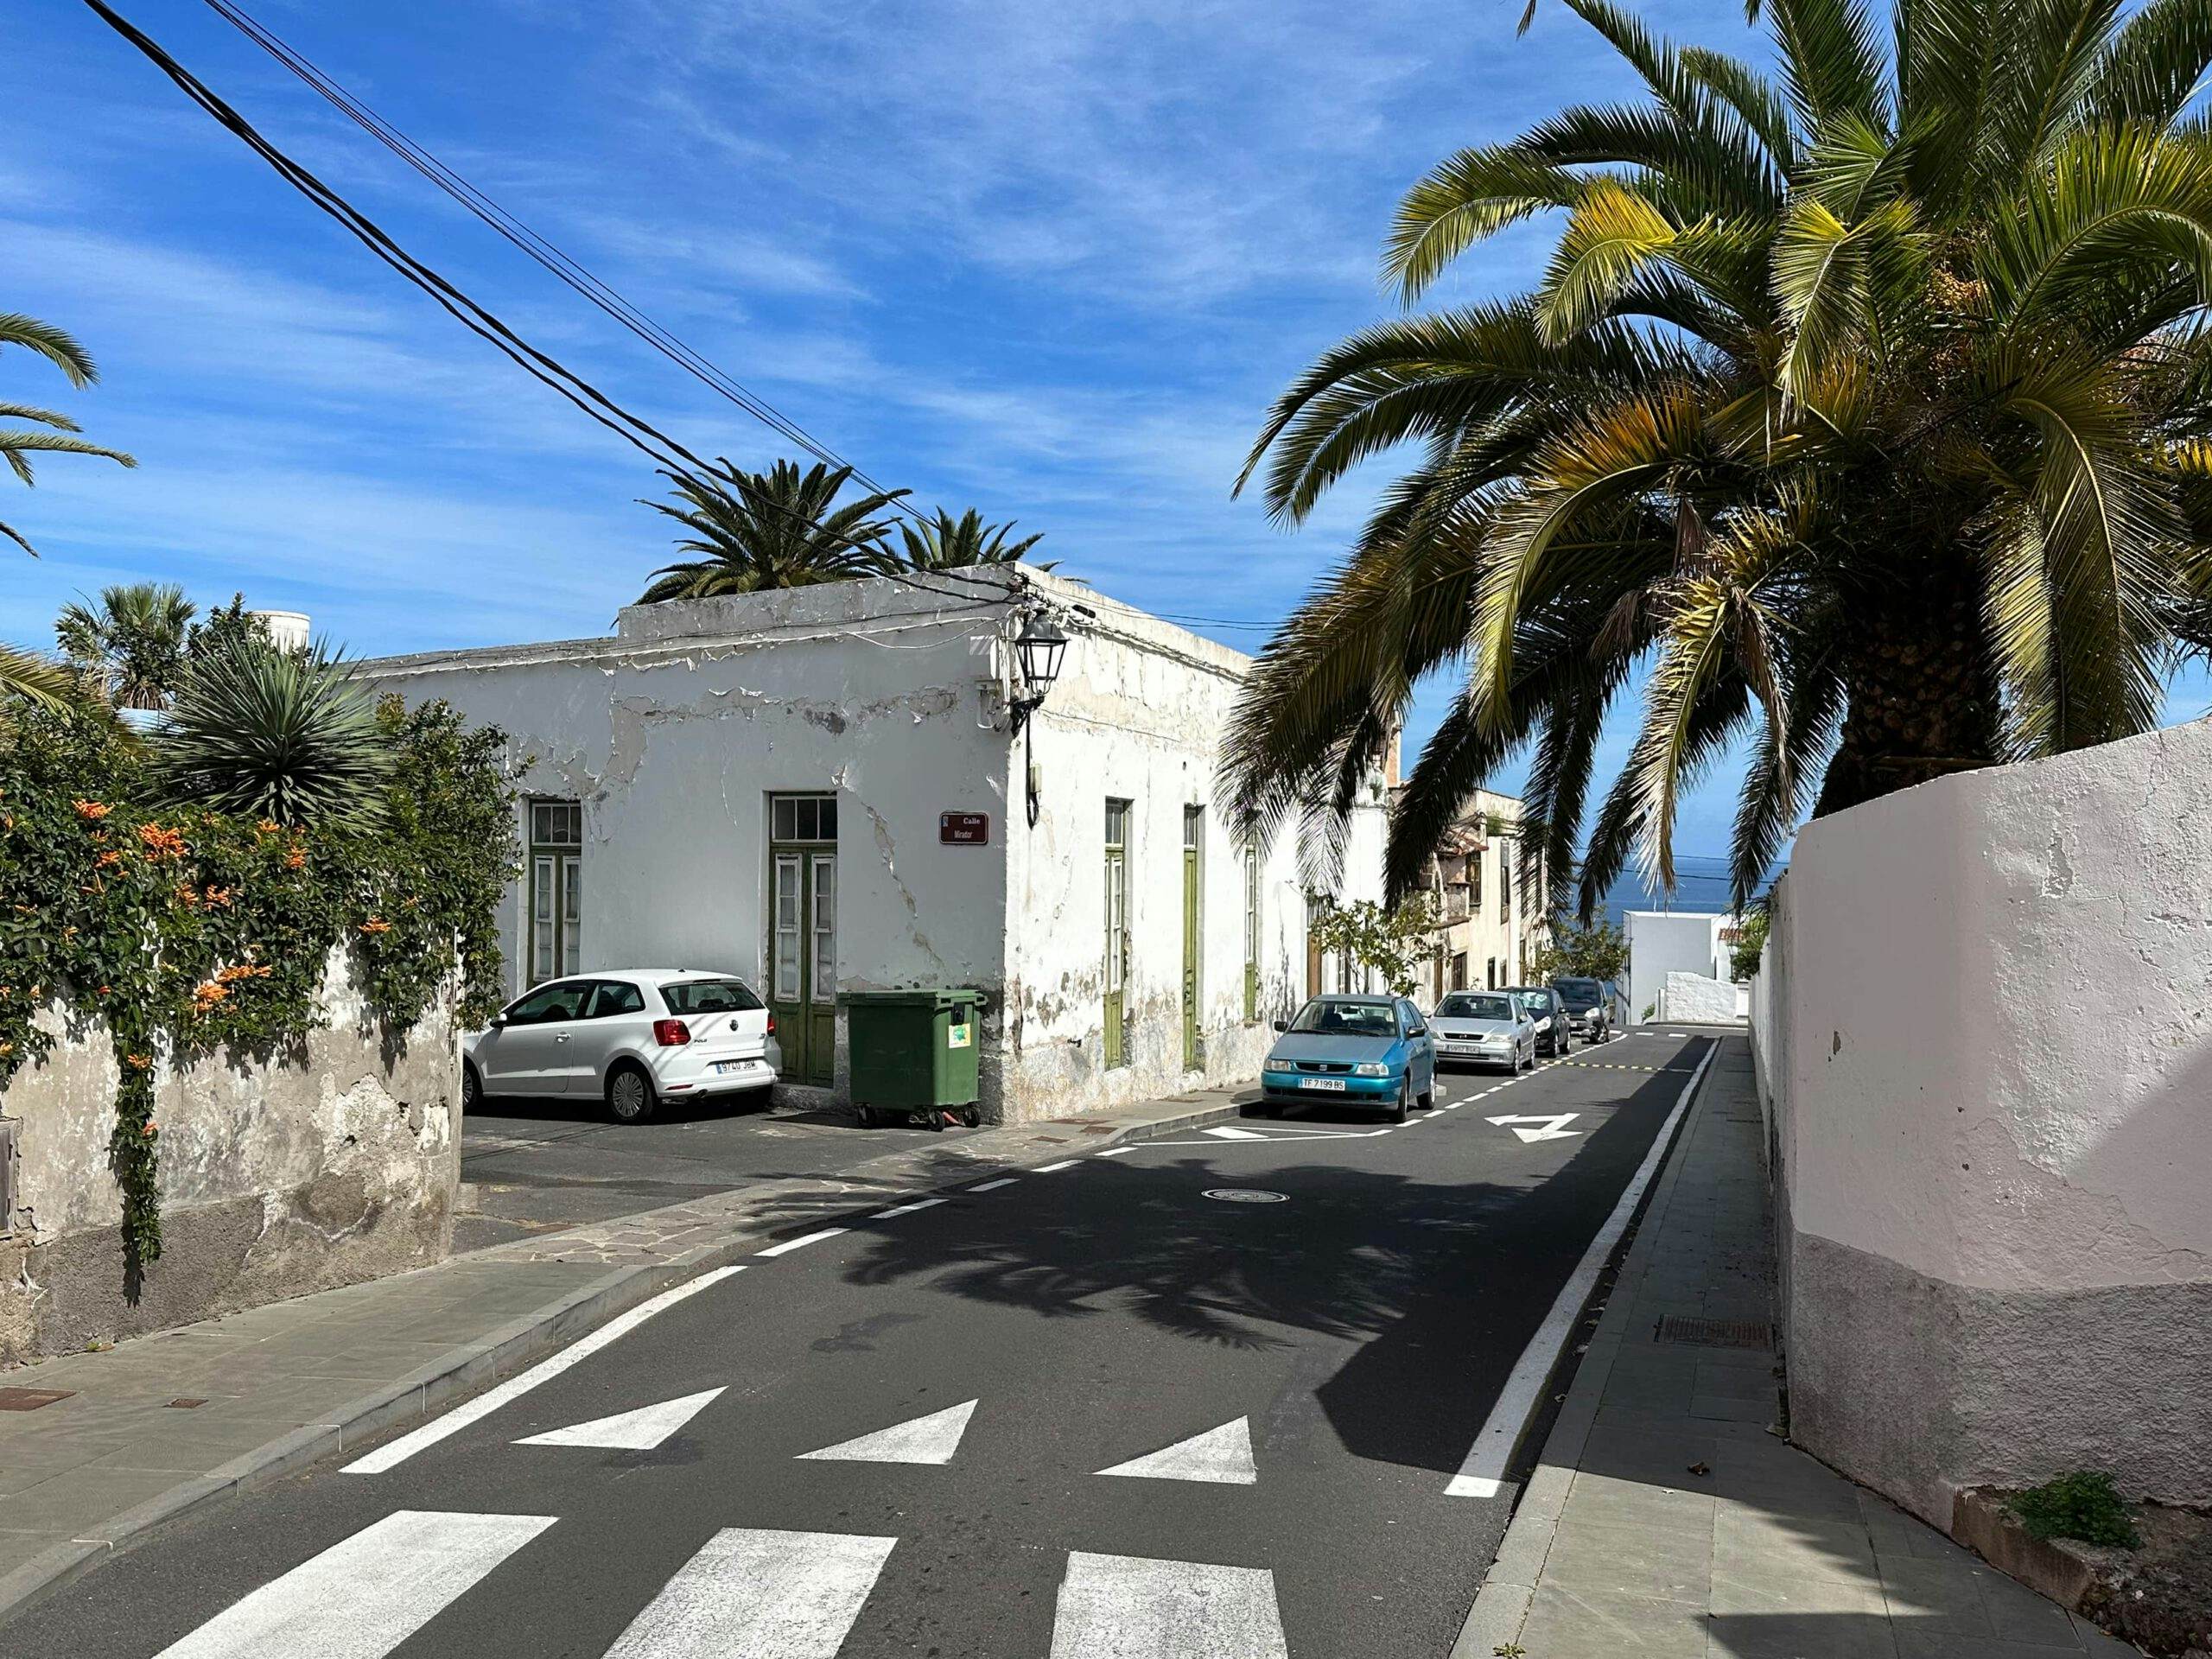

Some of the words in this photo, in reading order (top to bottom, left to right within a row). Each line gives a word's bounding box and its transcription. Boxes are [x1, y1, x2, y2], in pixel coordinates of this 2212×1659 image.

[954, 830, 973, 838] Mirador
[1303, 1078, 1313, 1087] TF
[1313, 1079, 1333, 1089] 7199
